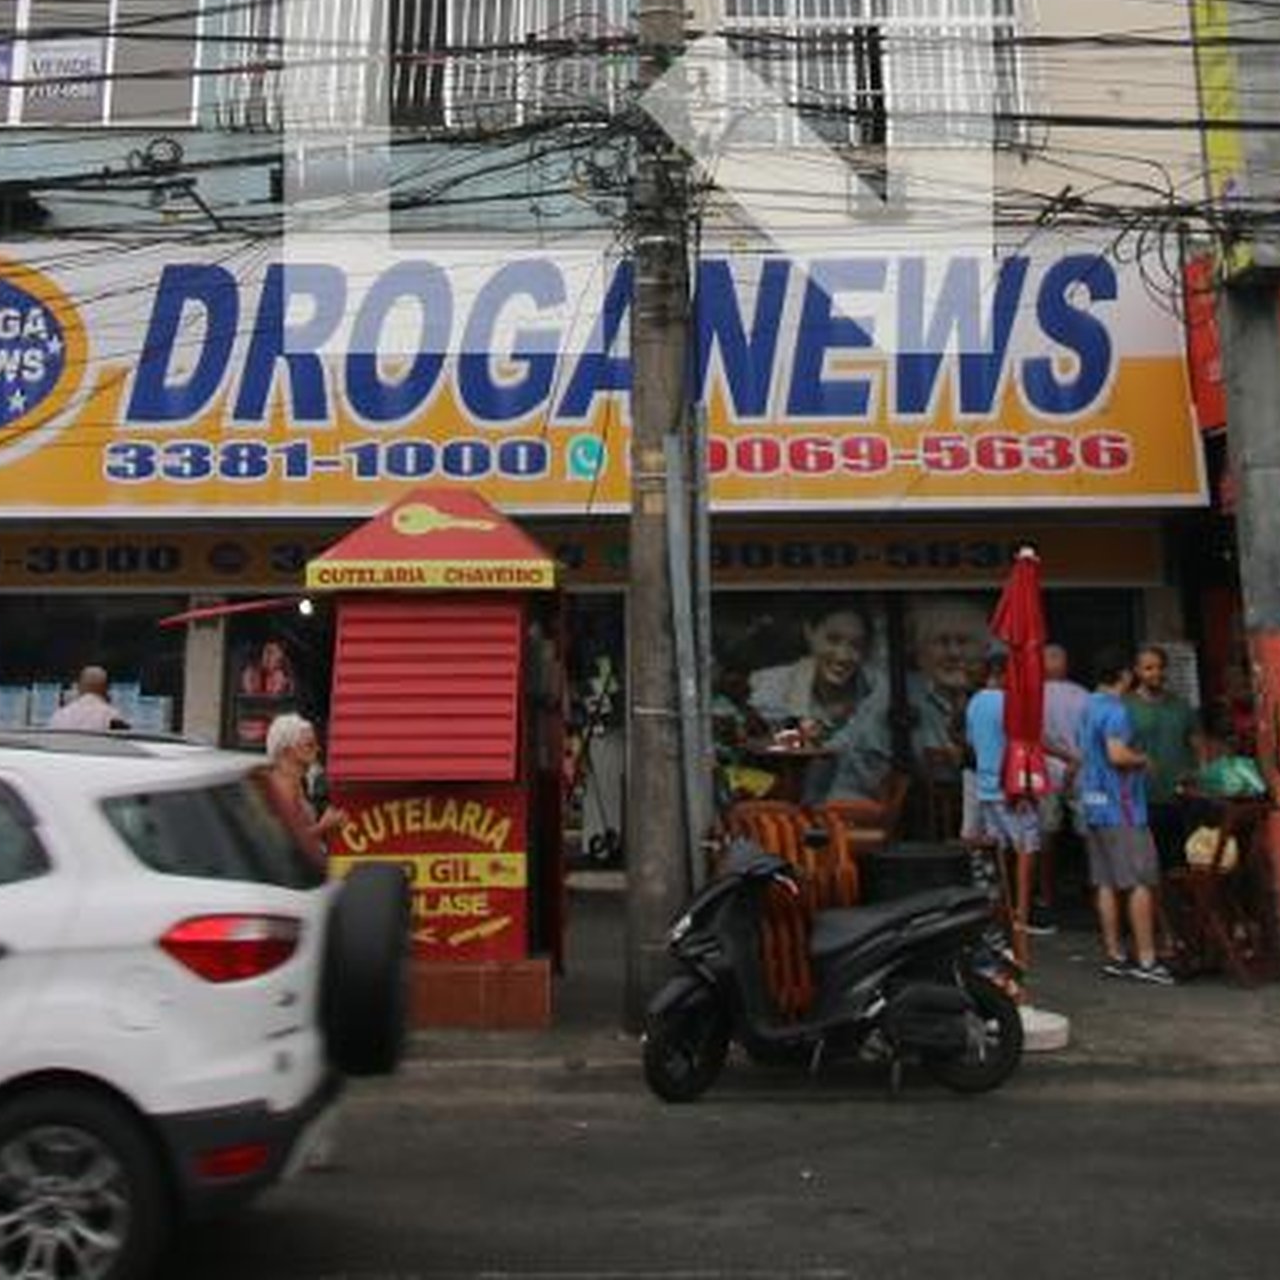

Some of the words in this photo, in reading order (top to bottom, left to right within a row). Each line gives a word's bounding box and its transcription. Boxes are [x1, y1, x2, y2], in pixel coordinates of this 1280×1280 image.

[124, 254, 1118, 422] DROGANEWS
[106, 440, 548, 479] 3381-1000
[319, 567, 426, 584] CUTELARIA
[341, 796, 512, 853] CUTELARIA
